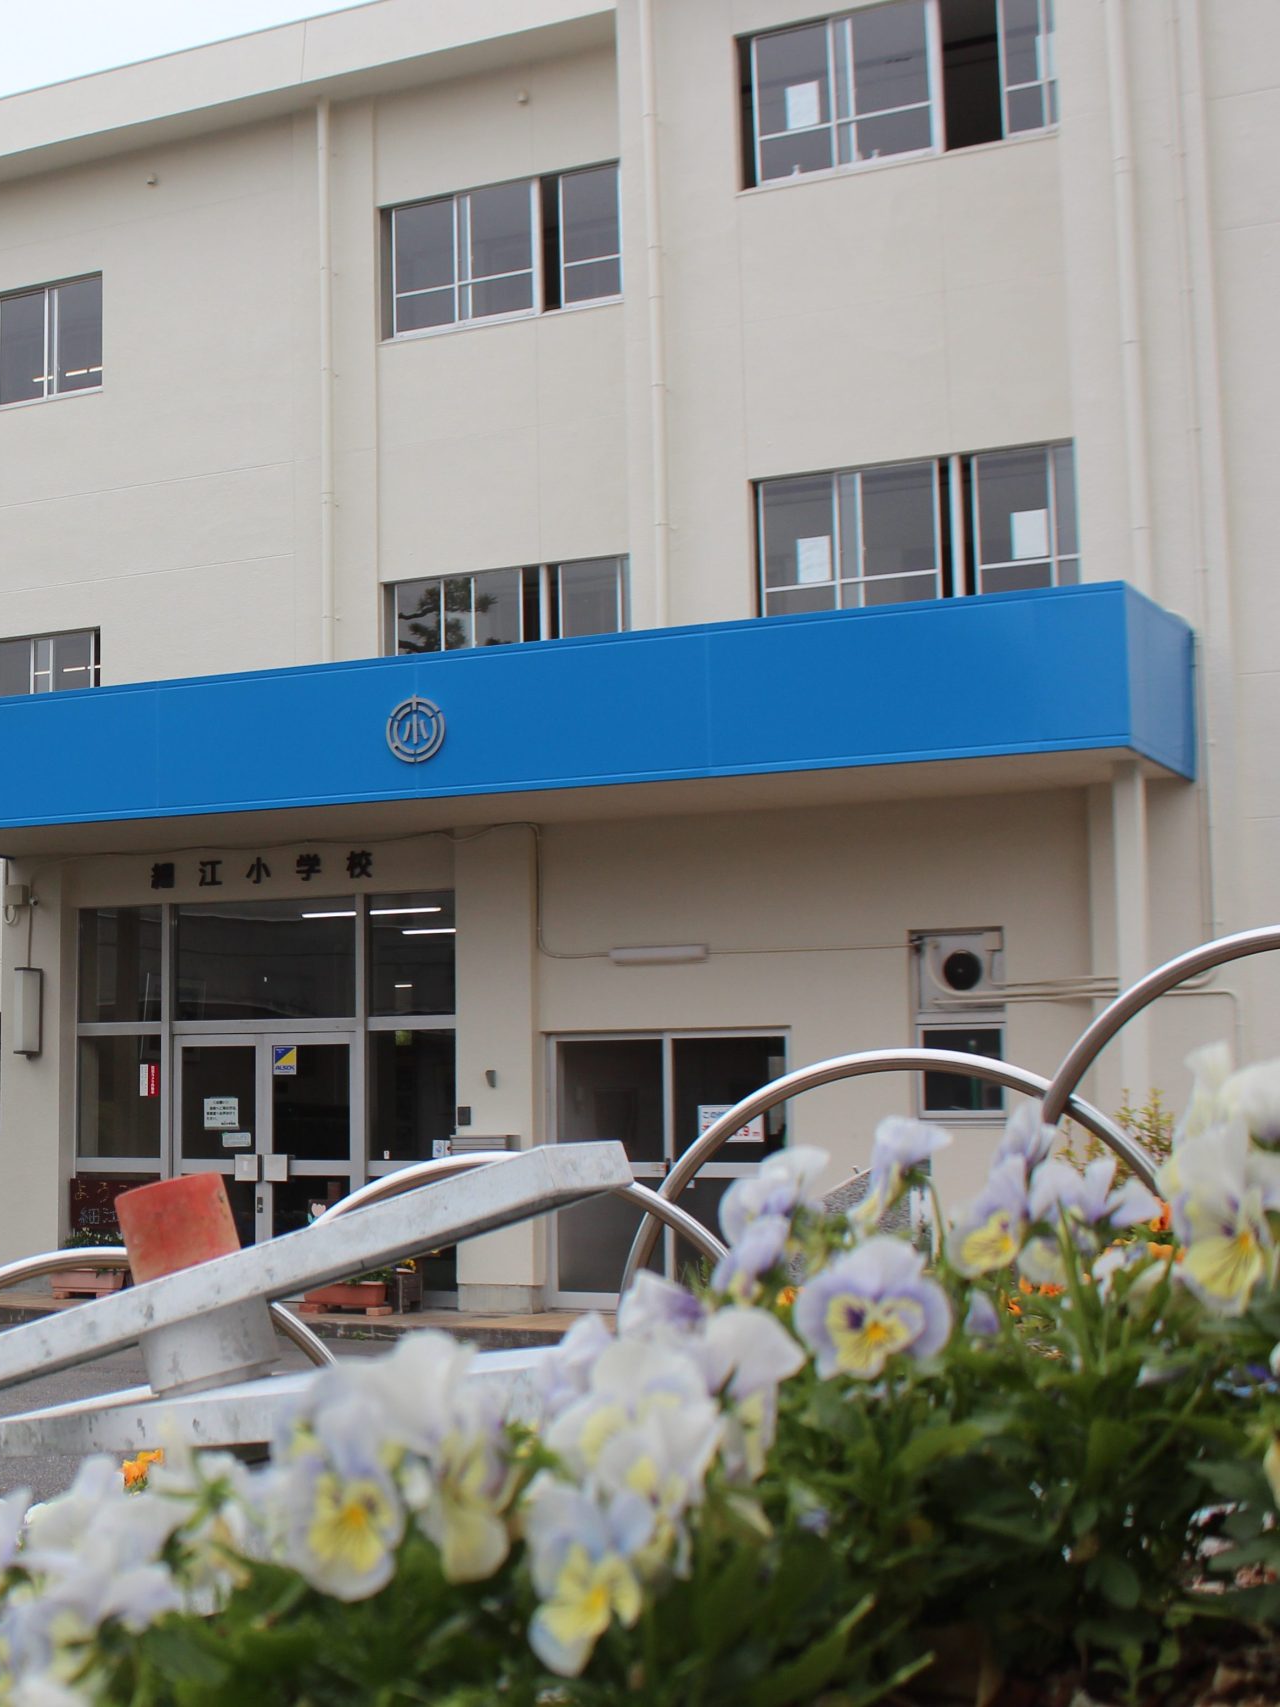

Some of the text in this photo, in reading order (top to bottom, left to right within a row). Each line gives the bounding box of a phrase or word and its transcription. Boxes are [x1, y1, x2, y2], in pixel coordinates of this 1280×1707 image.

[150, 850, 373, 889] 細江小学校
